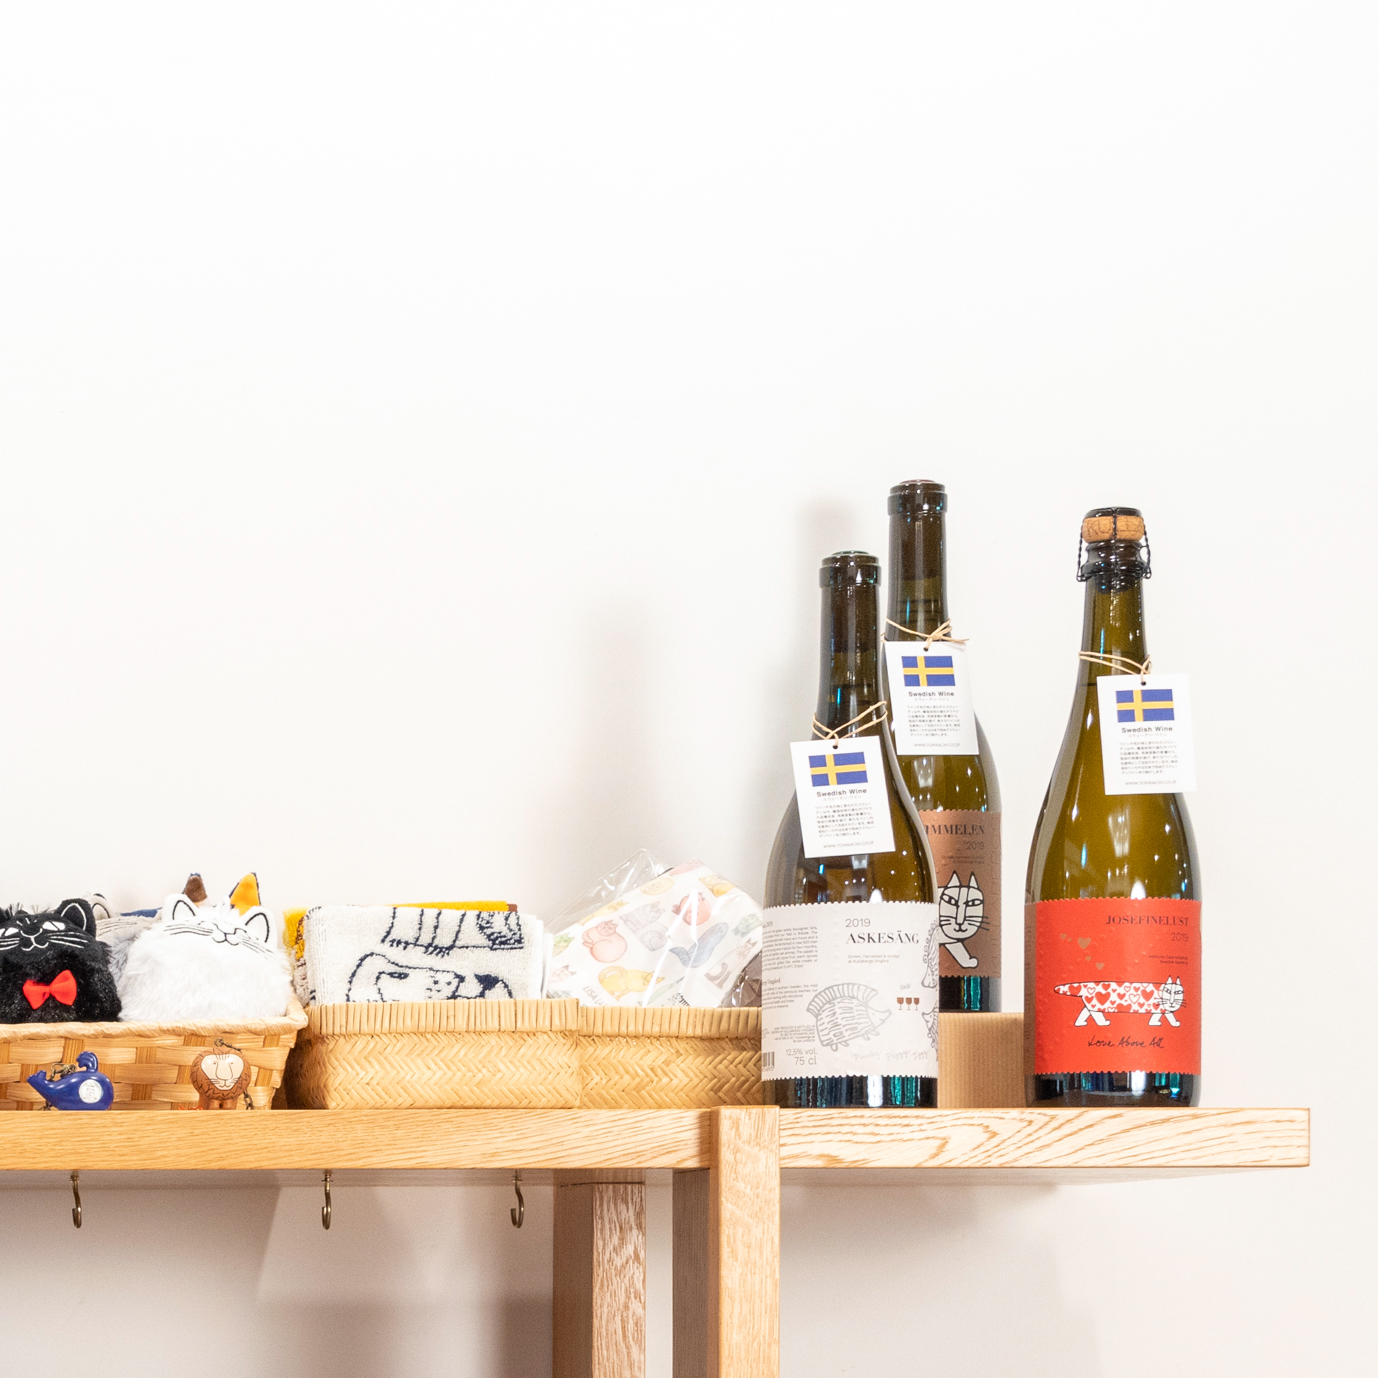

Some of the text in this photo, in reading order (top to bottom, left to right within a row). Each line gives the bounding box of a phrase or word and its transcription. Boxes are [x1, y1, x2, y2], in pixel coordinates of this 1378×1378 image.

[816, 789, 847, 797] Swedish
[966, 841, 985, 851] 2019
[845, 918, 871, 928] 2019
[1105, 915, 1190, 927] JOSEFINELUST
[846, 930, 919, 945] ASKESÄNG
[1170, 932, 1189, 942] 2019
[794, 1056, 805, 1065] 75
